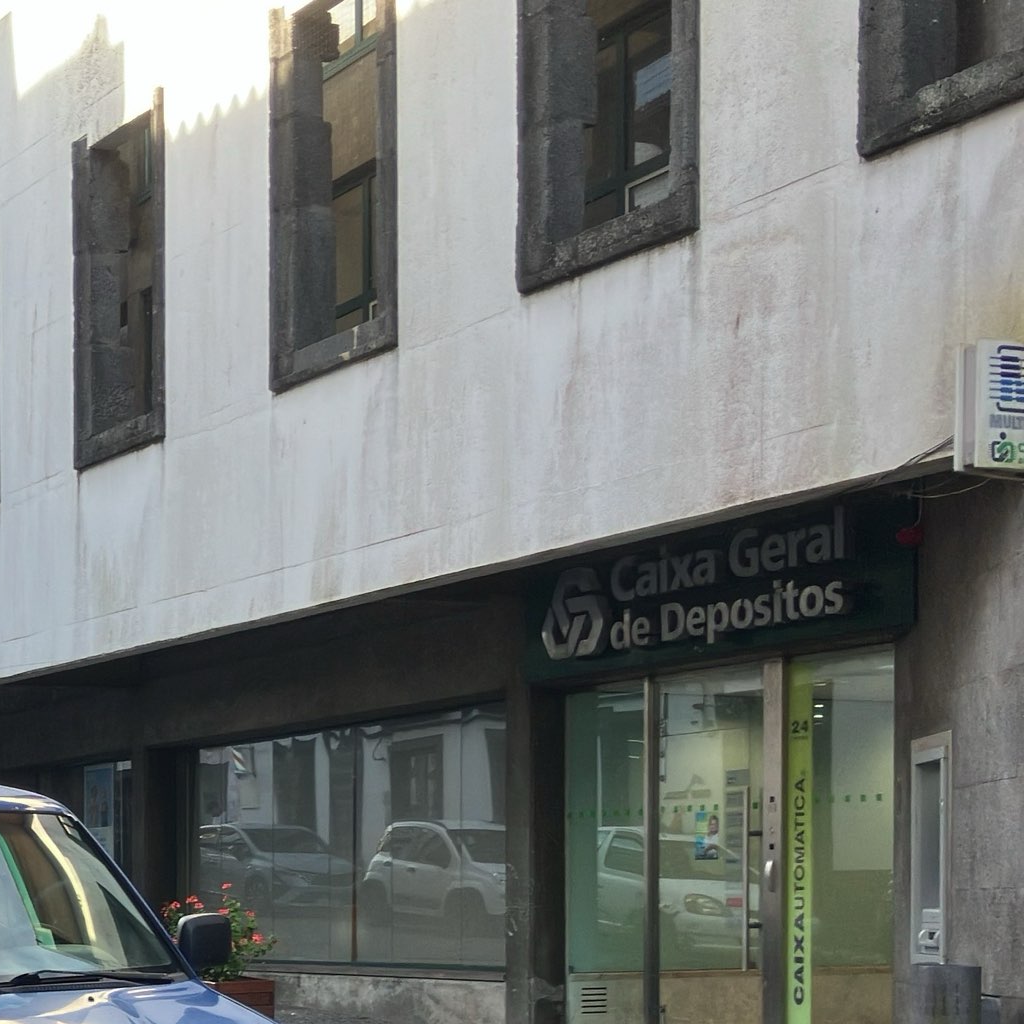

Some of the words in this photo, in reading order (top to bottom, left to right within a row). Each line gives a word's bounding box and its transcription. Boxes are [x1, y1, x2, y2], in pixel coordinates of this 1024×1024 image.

[610, 545, 716, 601] Caixa
[729, 505, 846, 577] Geral
[610, 609, 650, 650] de
[661, 580, 844, 644] Depositos
[791, 720, 809, 734] 24
[793, 778, 805, 1006] CAIXAUTOMATICA
